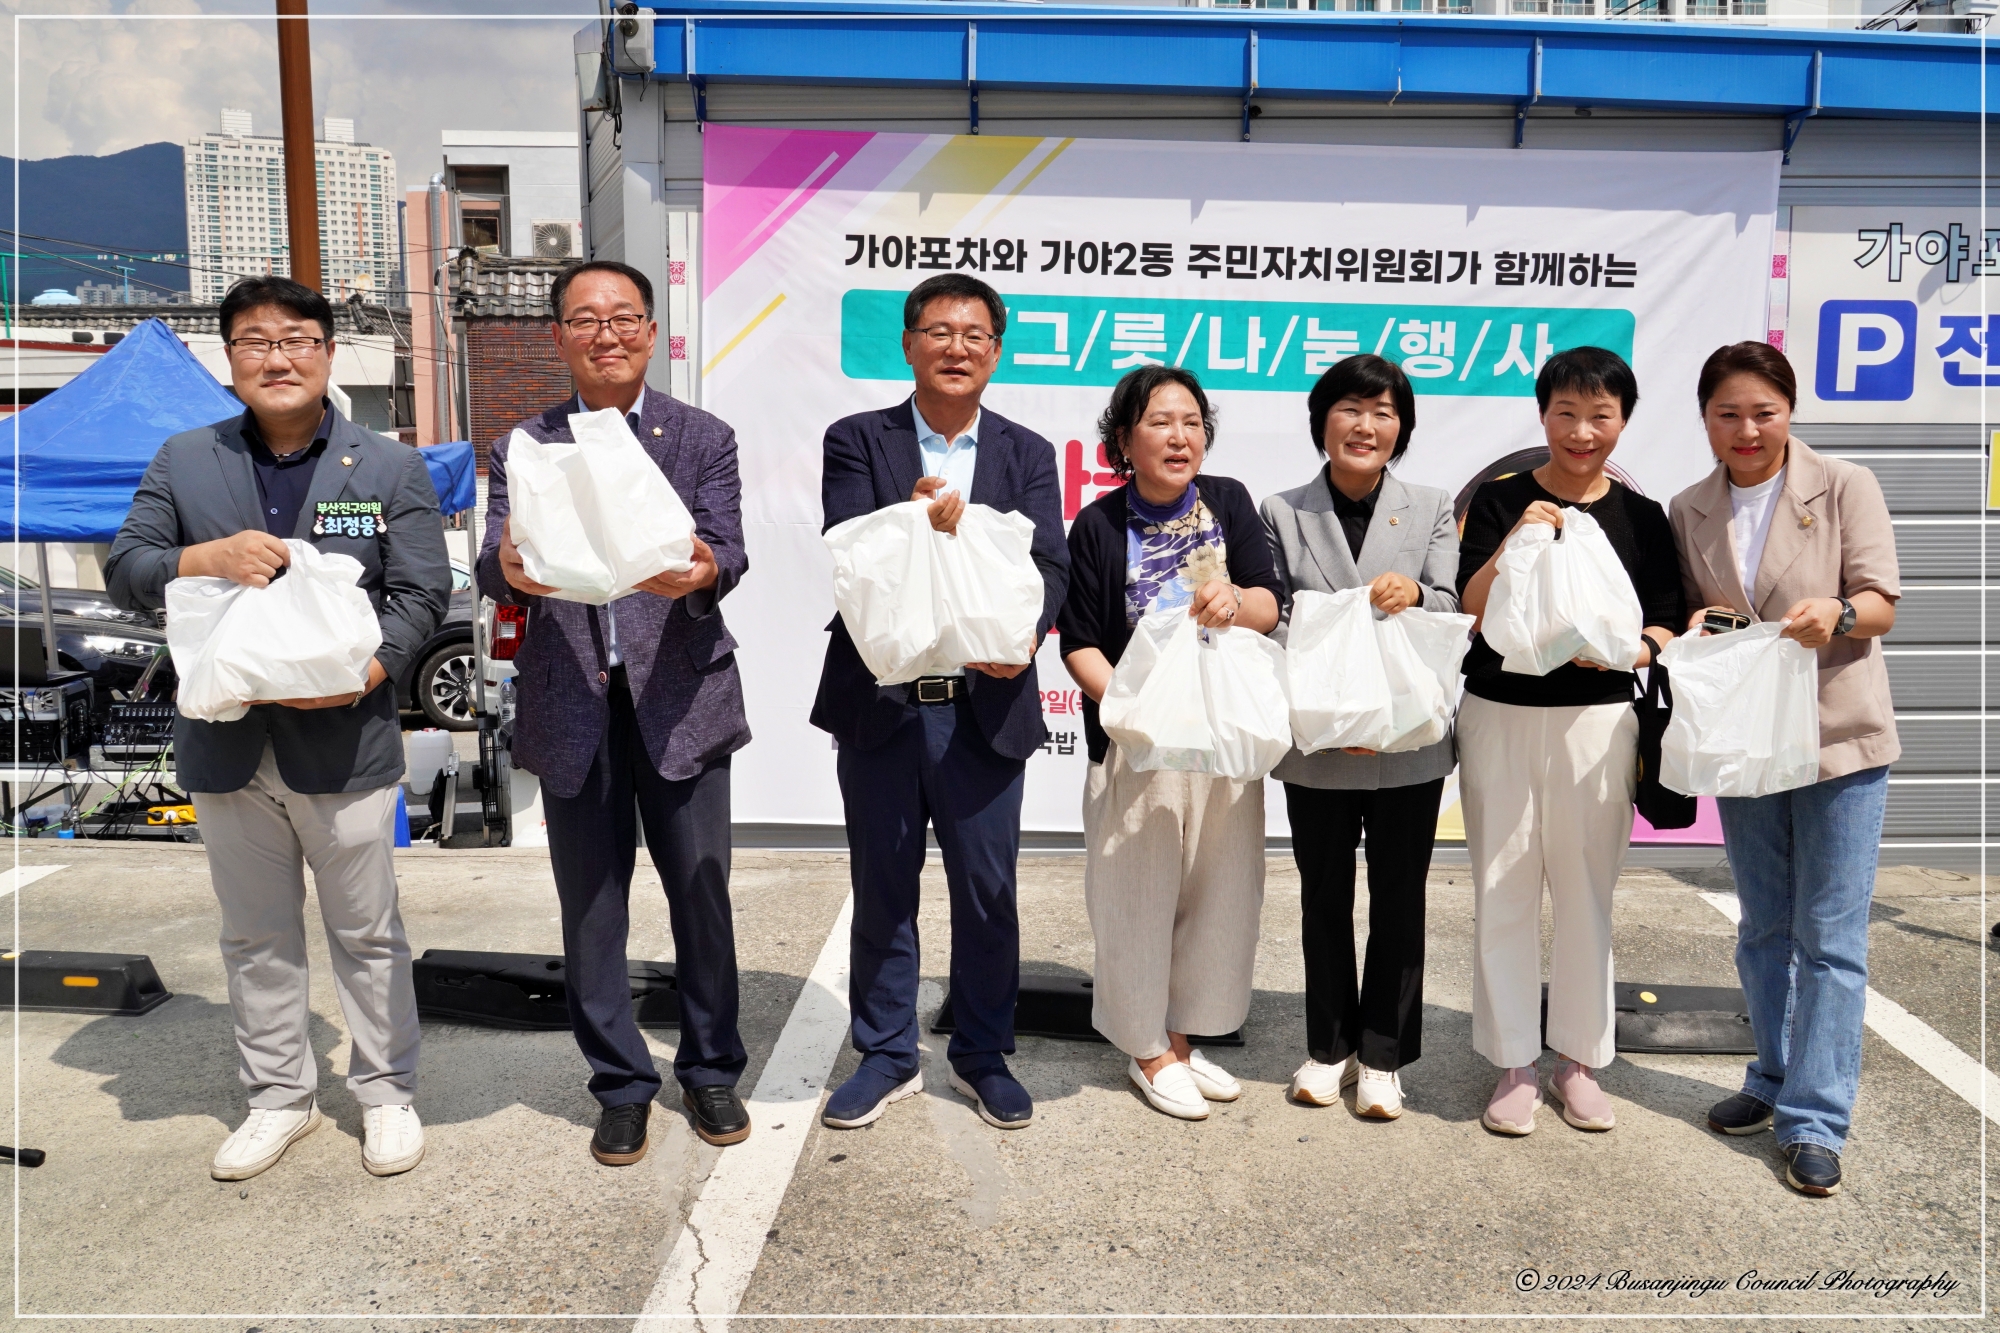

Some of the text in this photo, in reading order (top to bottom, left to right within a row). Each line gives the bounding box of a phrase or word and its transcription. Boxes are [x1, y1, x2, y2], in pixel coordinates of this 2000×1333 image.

[844, 233, 1637, 288] 가야포차와 가야2동 주민자치위원회가 함께하는
[317, 502, 382, 514] 부산진구의원
[324, 515, 376, 537] 최정웅
